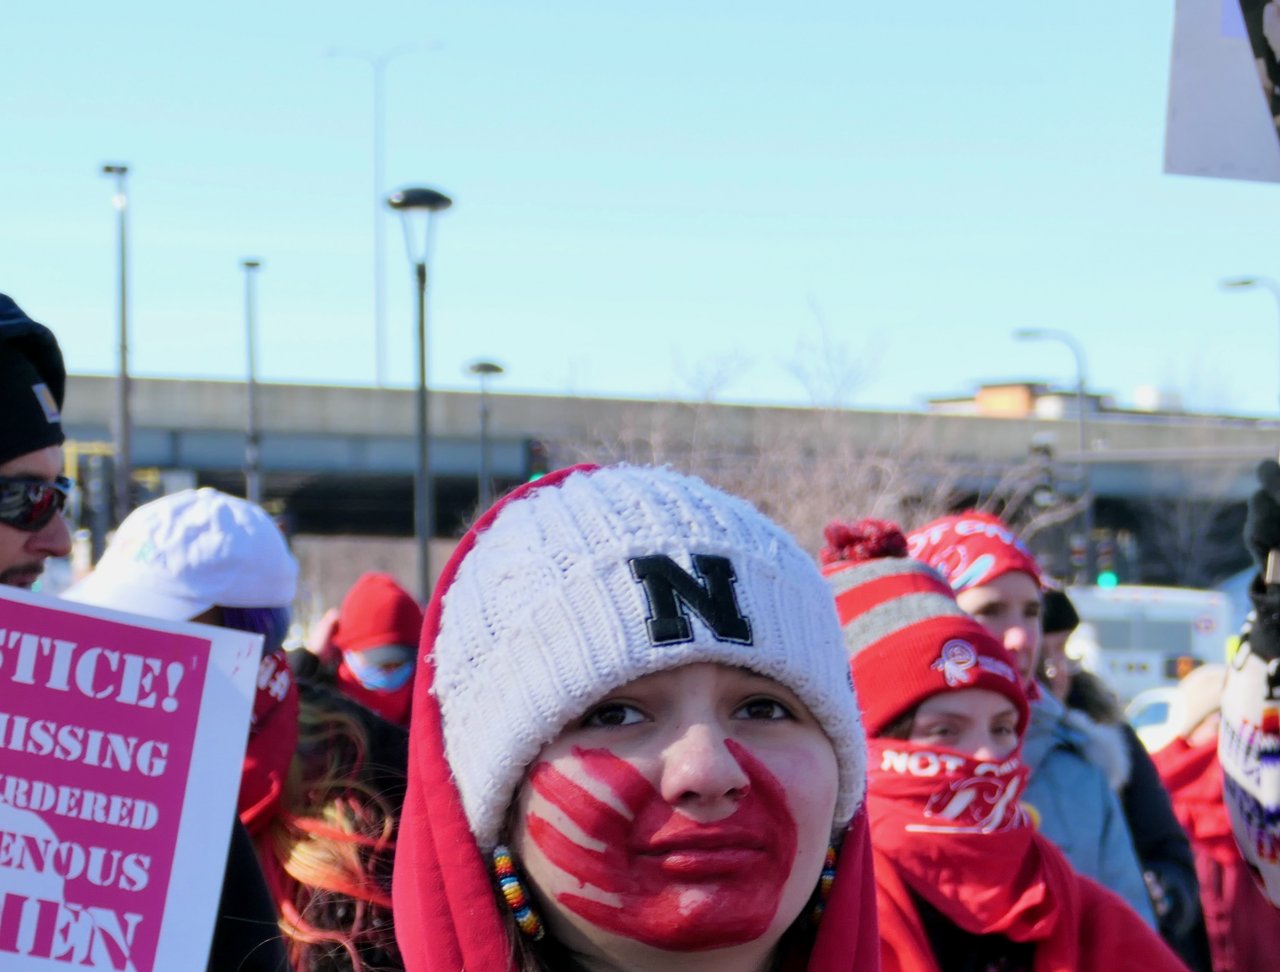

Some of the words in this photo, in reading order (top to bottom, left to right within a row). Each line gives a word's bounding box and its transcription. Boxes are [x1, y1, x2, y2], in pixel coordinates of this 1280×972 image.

[628, 553, 753, 647] N
[0, 628, 185, 713] TICE!
[881, 750, 966, 777] NOT
[0, 774, 159, 831] RDERED
